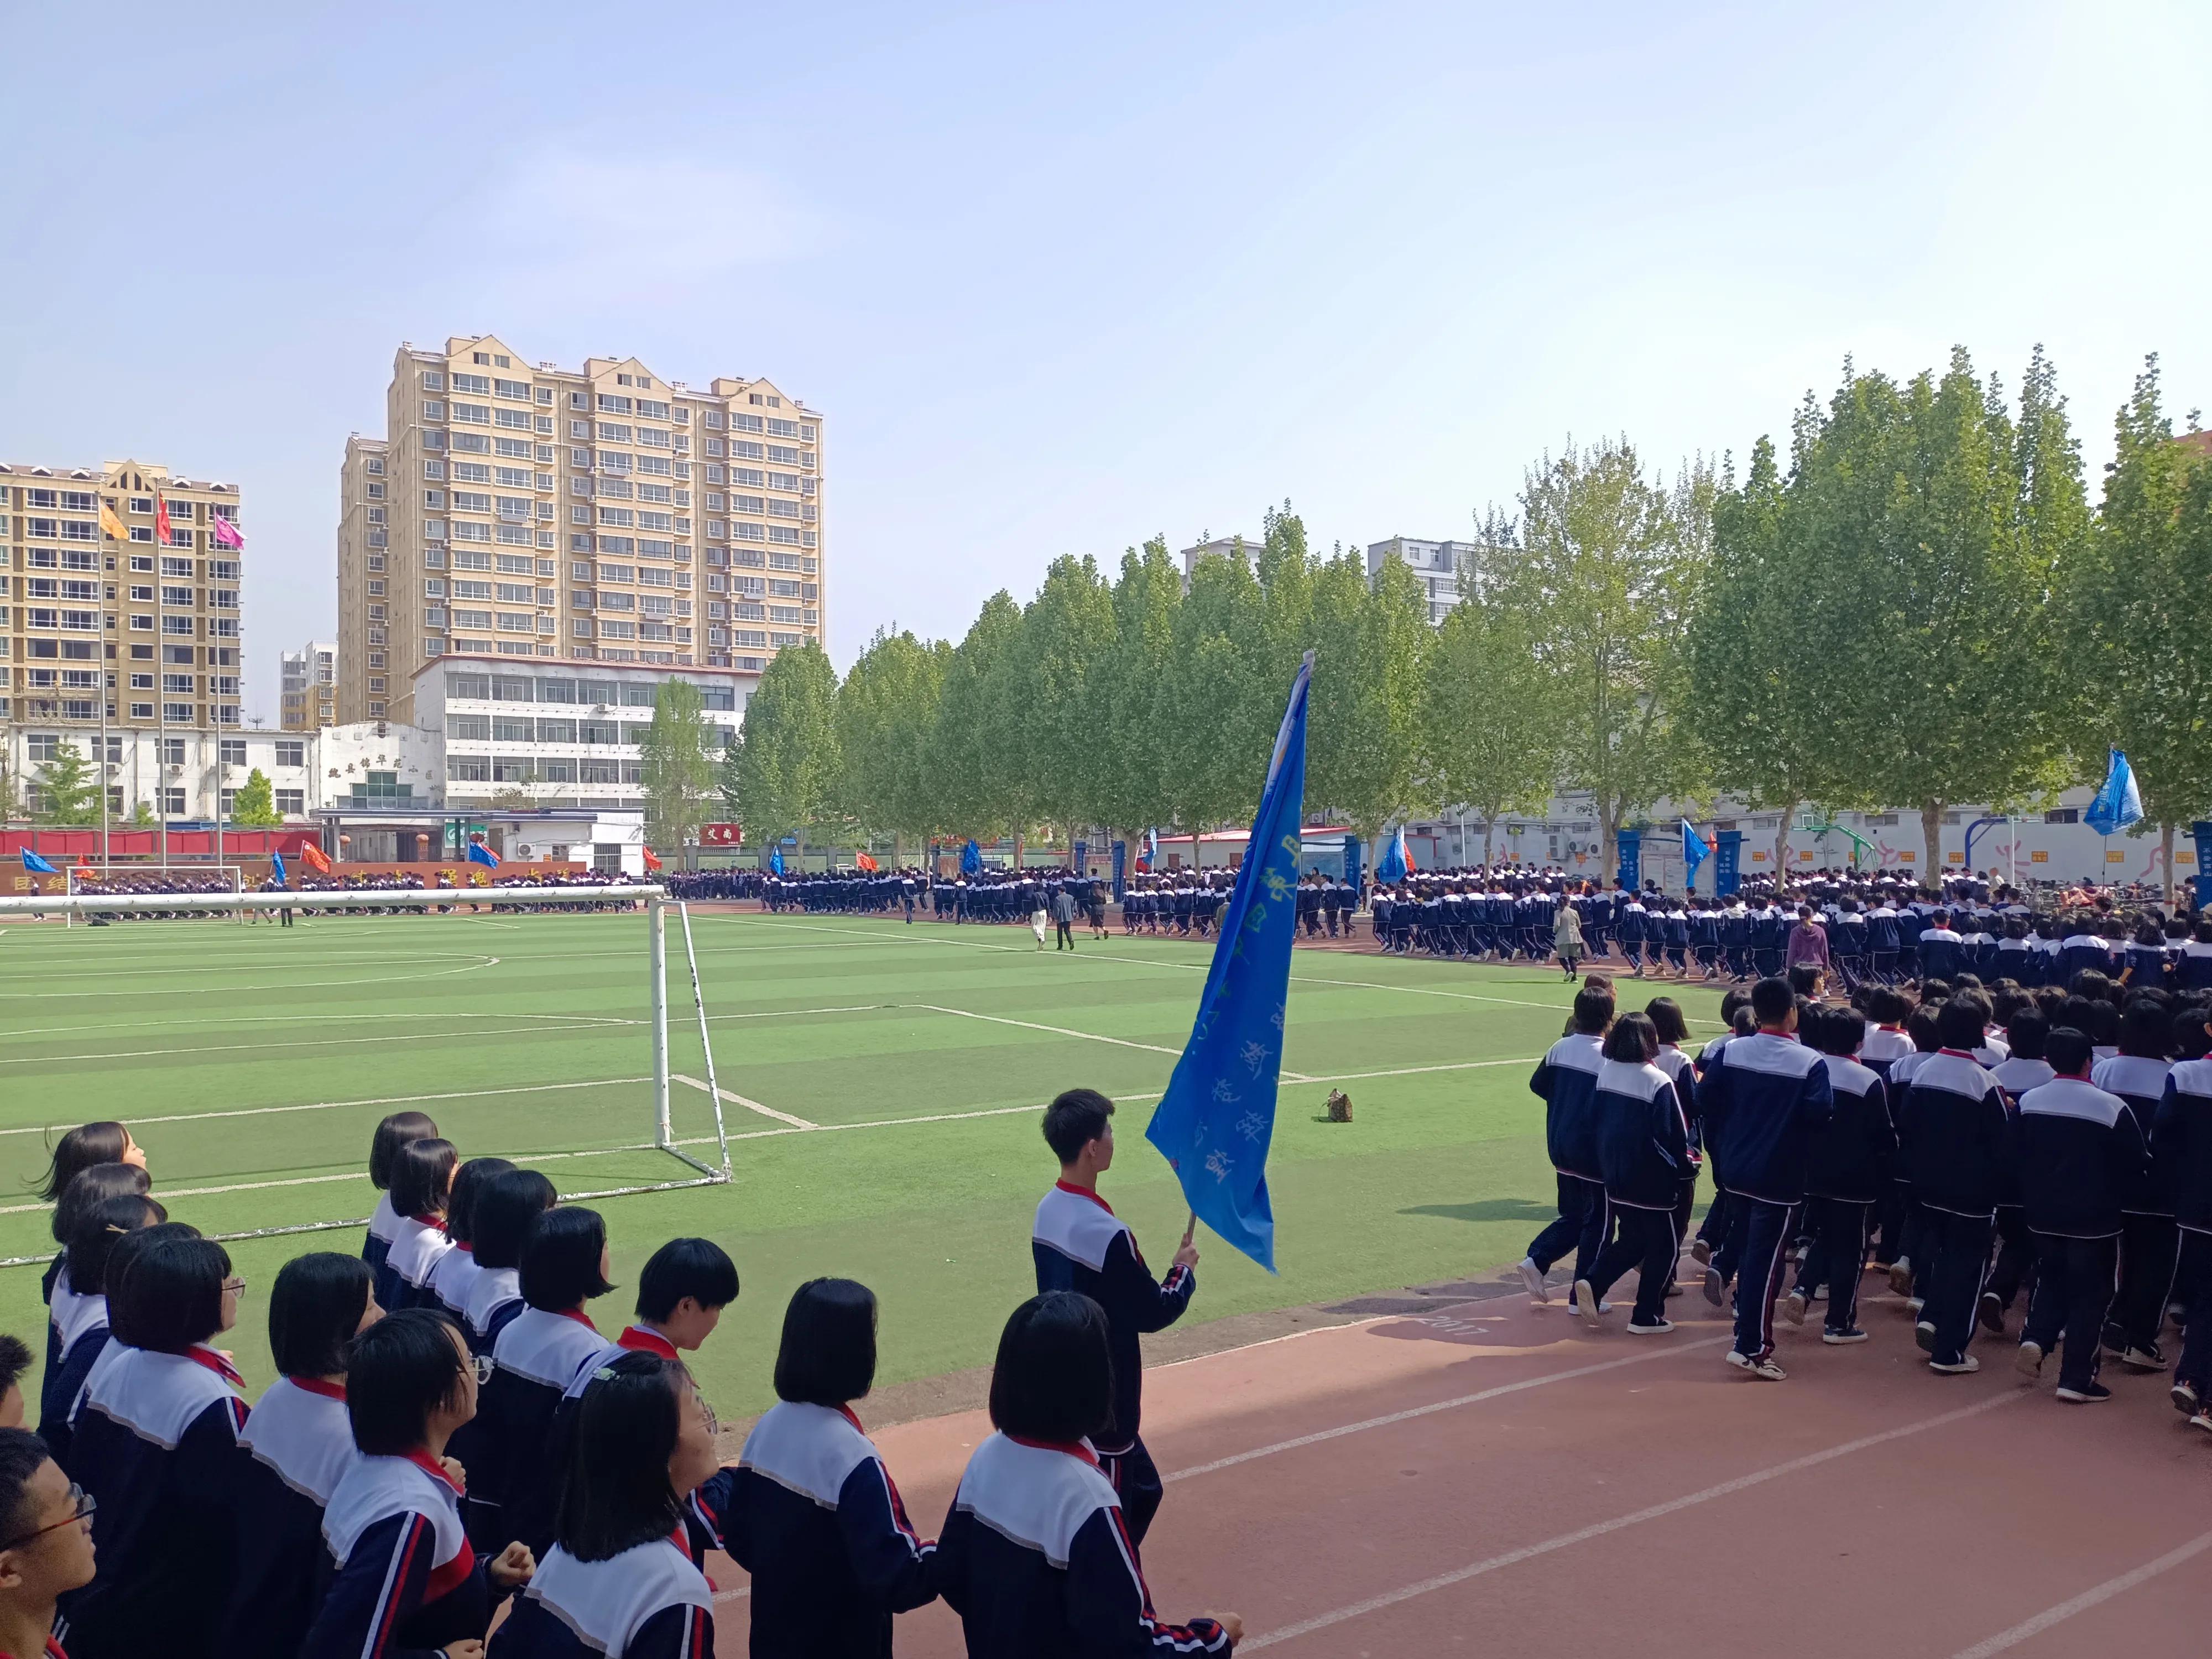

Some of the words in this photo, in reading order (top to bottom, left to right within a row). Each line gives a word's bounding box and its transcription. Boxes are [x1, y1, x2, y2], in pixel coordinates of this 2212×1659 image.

[328, 754, 433, 780] 魏县锦华苑小区
[14, 876, 67, 891] 团结
[1415, 1316, 1491, 1335] 2017
